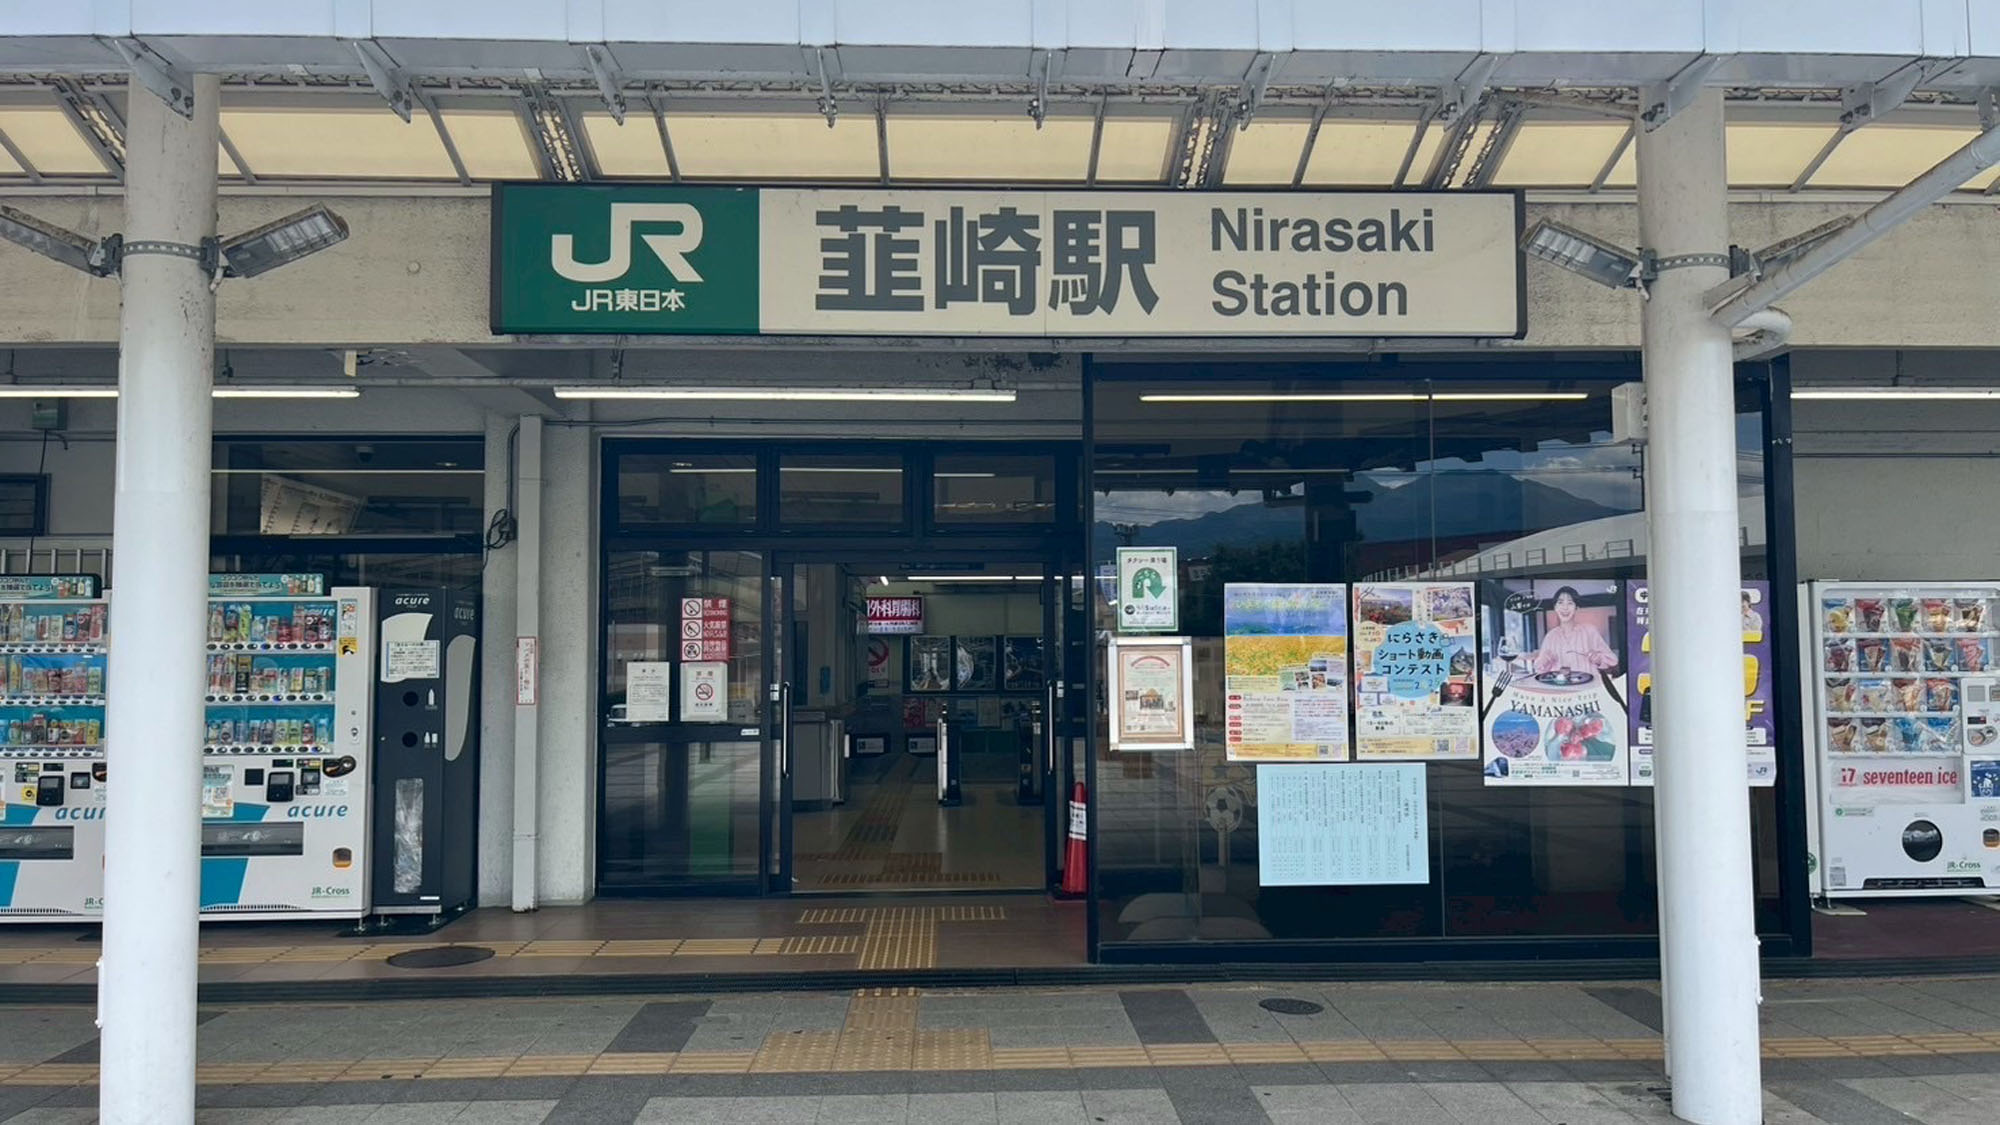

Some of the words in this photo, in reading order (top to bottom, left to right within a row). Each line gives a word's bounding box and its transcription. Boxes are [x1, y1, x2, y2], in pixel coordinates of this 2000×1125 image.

[1211, 207, 1434, 252] Nirasaki
[551, 202, 704, 283] JR
[815, 204, 1160, 316] 韮崎駅
[571, 288, 686, 312] JR東日本
[1212, 270, 1408, 316] Station
[395, 596, 430, 605] acure
[1387, 632, 1438, 644] にらさき
[1378, 648, 1444, 661] ショート動画
[1382, 663, 1445, 675] コンテスト
[1510, 700, 1601, 718] YAMANASHI
[1863, 770, 1933, 785] seventeen
[1937, 766, 1957, 784] ice
[287, 804, 348, 818] acure
[312, 886, 350, 896] JR-Cross
